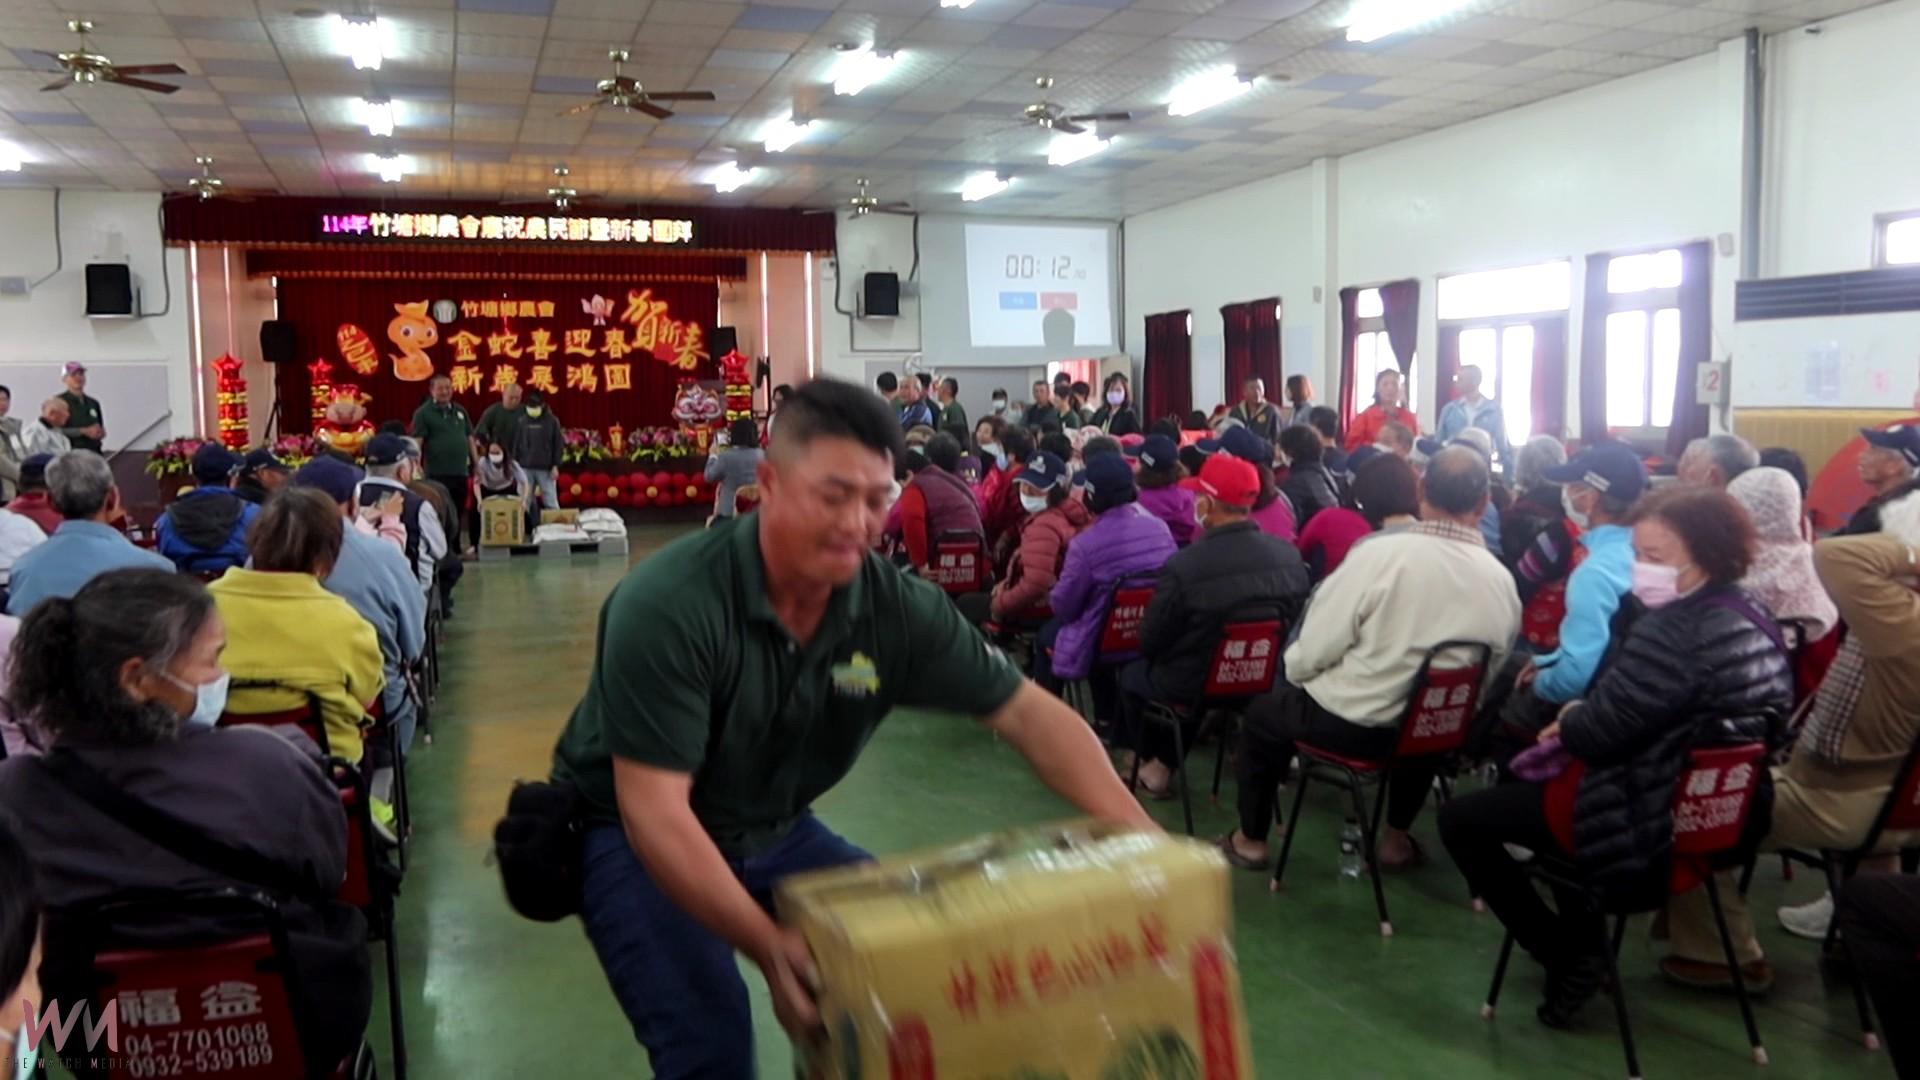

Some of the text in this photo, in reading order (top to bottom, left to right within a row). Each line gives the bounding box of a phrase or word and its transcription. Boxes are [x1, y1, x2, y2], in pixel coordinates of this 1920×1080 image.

[1005, 254, 1071, 279] 00:12
[447, 328, 632, 362] 金蛇喜迎春
[124, 1021, 269, 1056] 04-7701068
[129, 1043, 274, 1079] 0932-539189
